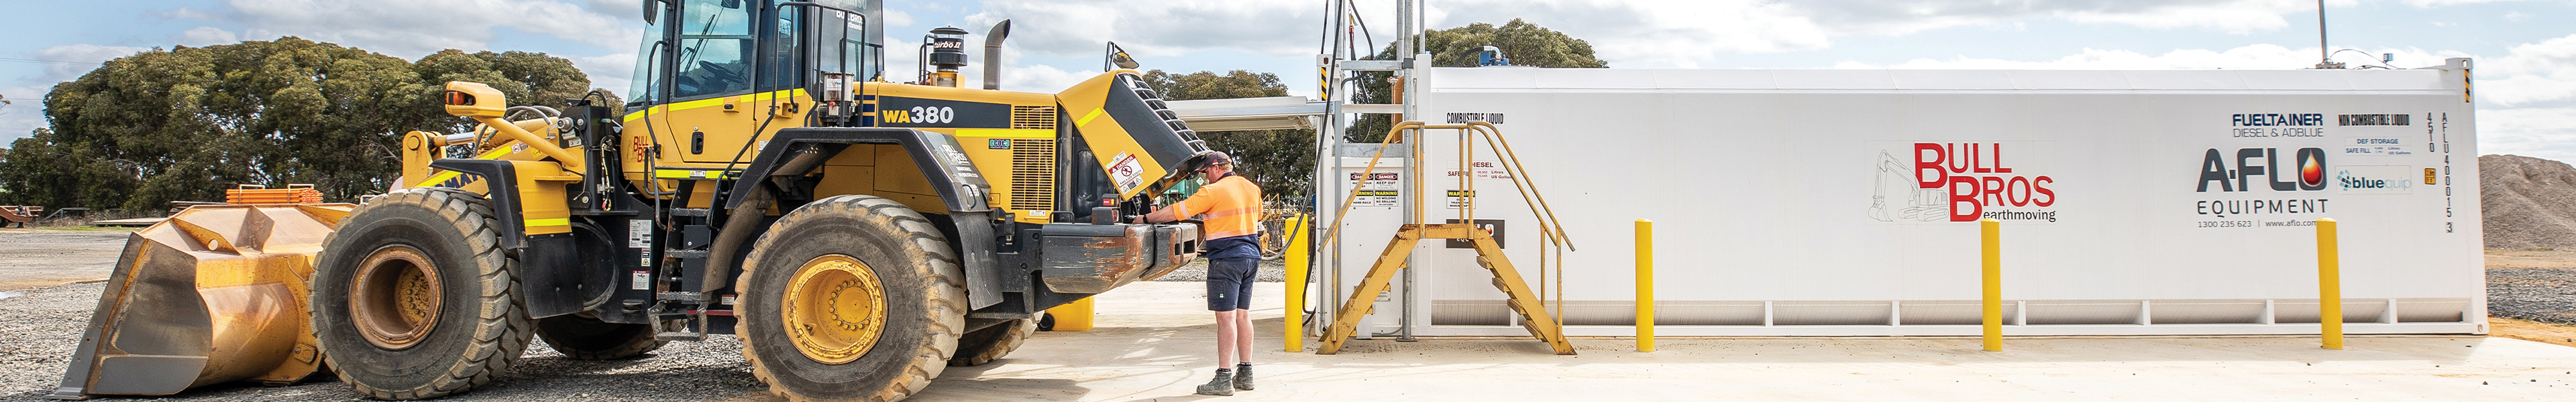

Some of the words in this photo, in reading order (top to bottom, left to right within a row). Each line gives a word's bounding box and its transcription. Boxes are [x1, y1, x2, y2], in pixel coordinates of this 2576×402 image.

[883, 106, 954, 123] WA380
[1487, 113, 1504, 125] LIQUID
[2233, 114, 2324, 127] FUELTAINER
[2339, 114, 2351, 126] NON
[2351, 114, 2390, 126] COMBUSTIBLE
[2391, 114, 2410, 126] LIQUID
[2234, 129, 2267, 137] DIESEL
[2271, 129, 2279, 137] &
[2282, 128, 2324, 137] ADBLUE
[633, 135, 649, 151] BULL
[1116, 155, 1134, 169] DANGER
[1915, 143, 2012, 189] BULL
[2352, 177, 2412, 191] bluequip
[1949, 176, 2055, 222] BROS
[1983, 209, 2056, 222] earthmoving
[2197, 200, 2328, 218] EQUIPMENT
